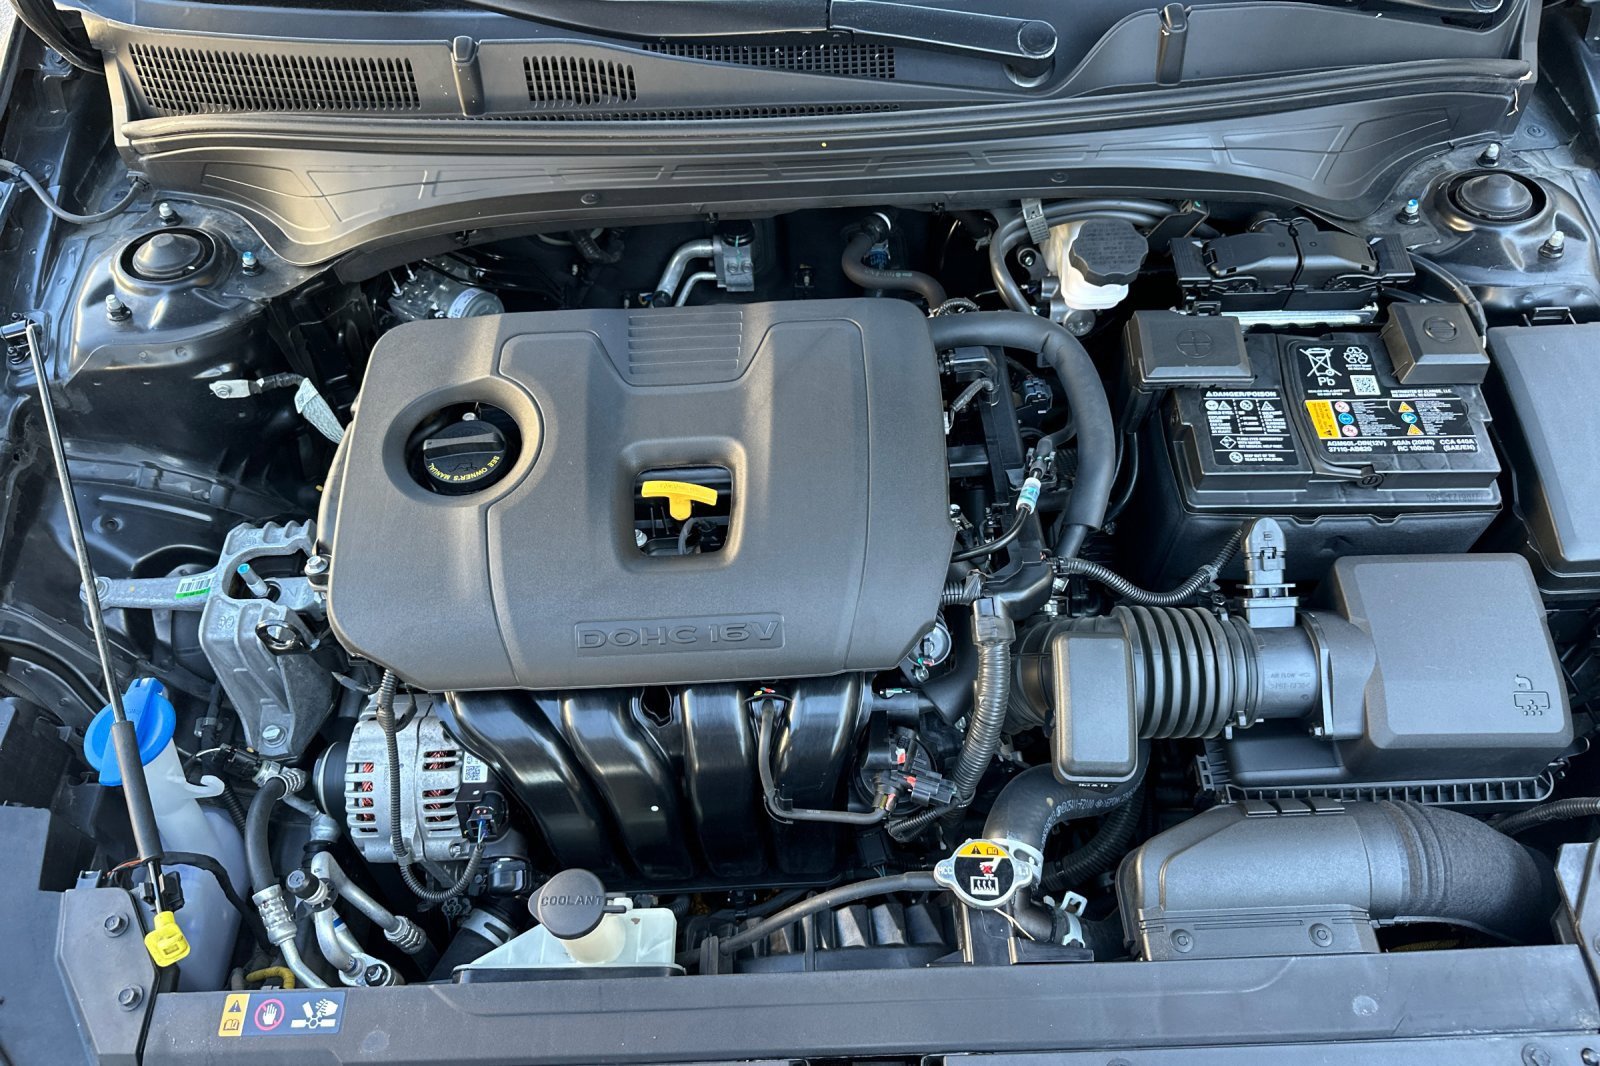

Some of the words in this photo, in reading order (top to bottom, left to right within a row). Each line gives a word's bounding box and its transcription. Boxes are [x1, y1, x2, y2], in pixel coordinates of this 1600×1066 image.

[1317, 376, 1336, 386] Pb
[487, 455, 500, 468] SEE
[428, 462, 451, 480] MANUAL
[453, 467, 488, 481] OWNER'S
[577, 625, 698, 649] DOHC
[708, 620, 780, 644] 16V
[541, 895, 604, 906] COOLANT
